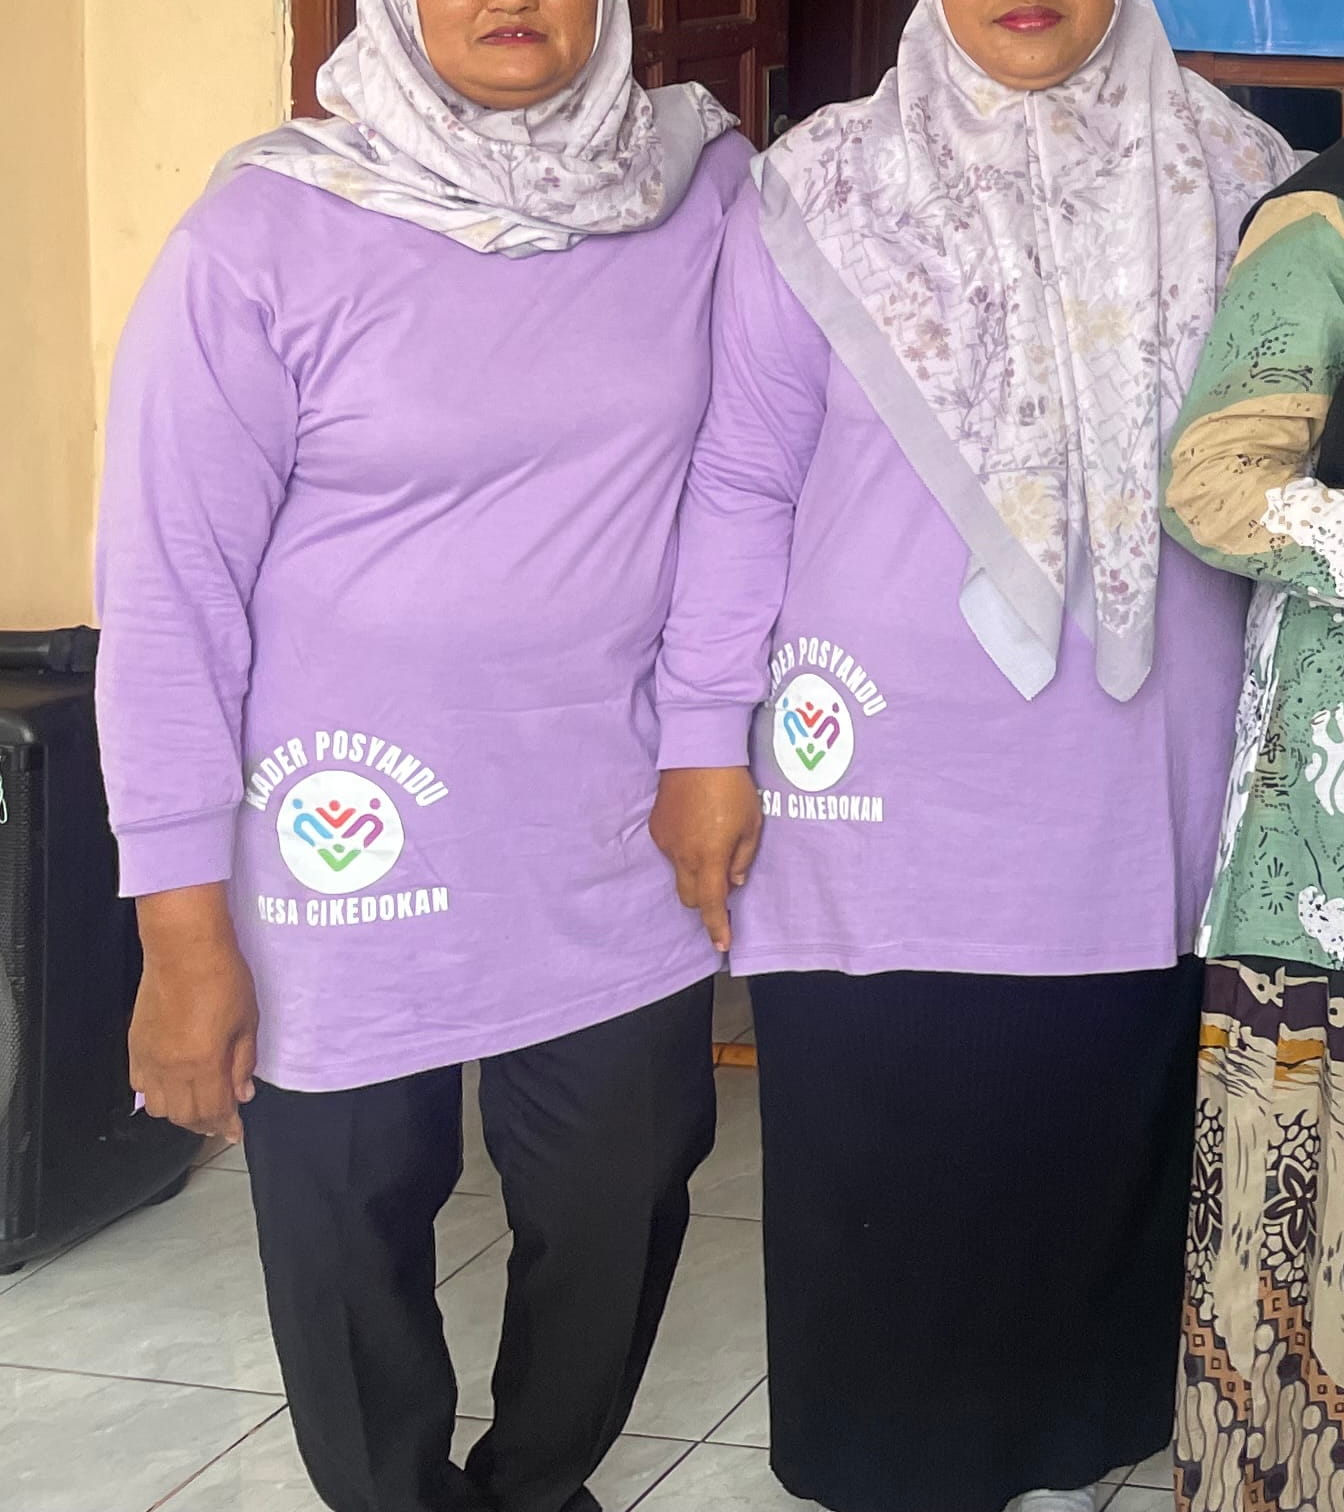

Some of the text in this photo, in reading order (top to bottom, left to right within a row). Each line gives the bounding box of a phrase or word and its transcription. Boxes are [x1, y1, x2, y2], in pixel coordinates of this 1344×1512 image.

[799, 636, 889, 717] POSYANDU
[314, 729, 449, 807] POSYANDU
[787, 792, 884, 822] CIKEDOKAN
[306, 886, 449, 927] CIKEDOKAN
